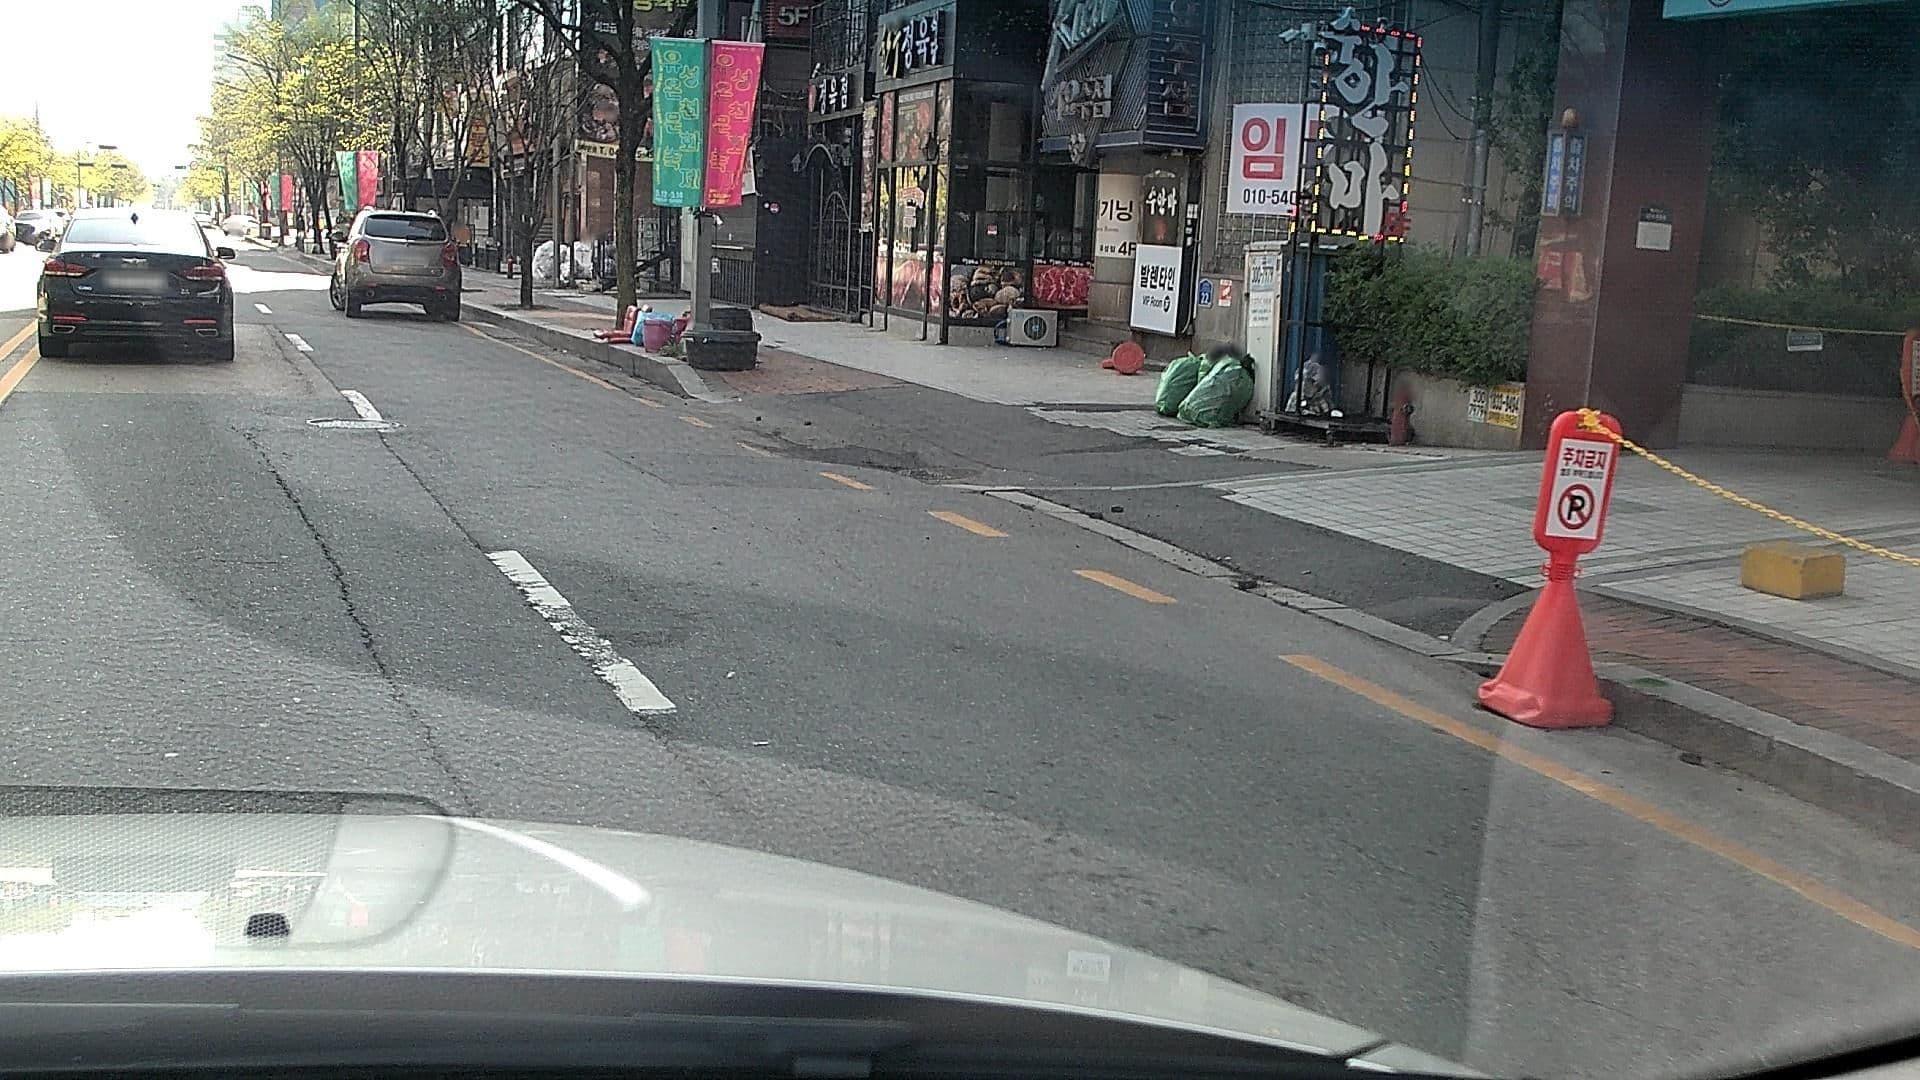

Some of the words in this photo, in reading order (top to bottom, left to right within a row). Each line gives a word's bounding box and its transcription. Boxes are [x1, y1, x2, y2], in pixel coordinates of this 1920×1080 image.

[777, 6, 808, 25] 5F
[1118, 241, 1136, 257] 4F
[1140, 264, 1175, 291] 발렌타인
[1201, 292, 1210, 304] 22
[1563, 447, 1608, 470] 주차금지
